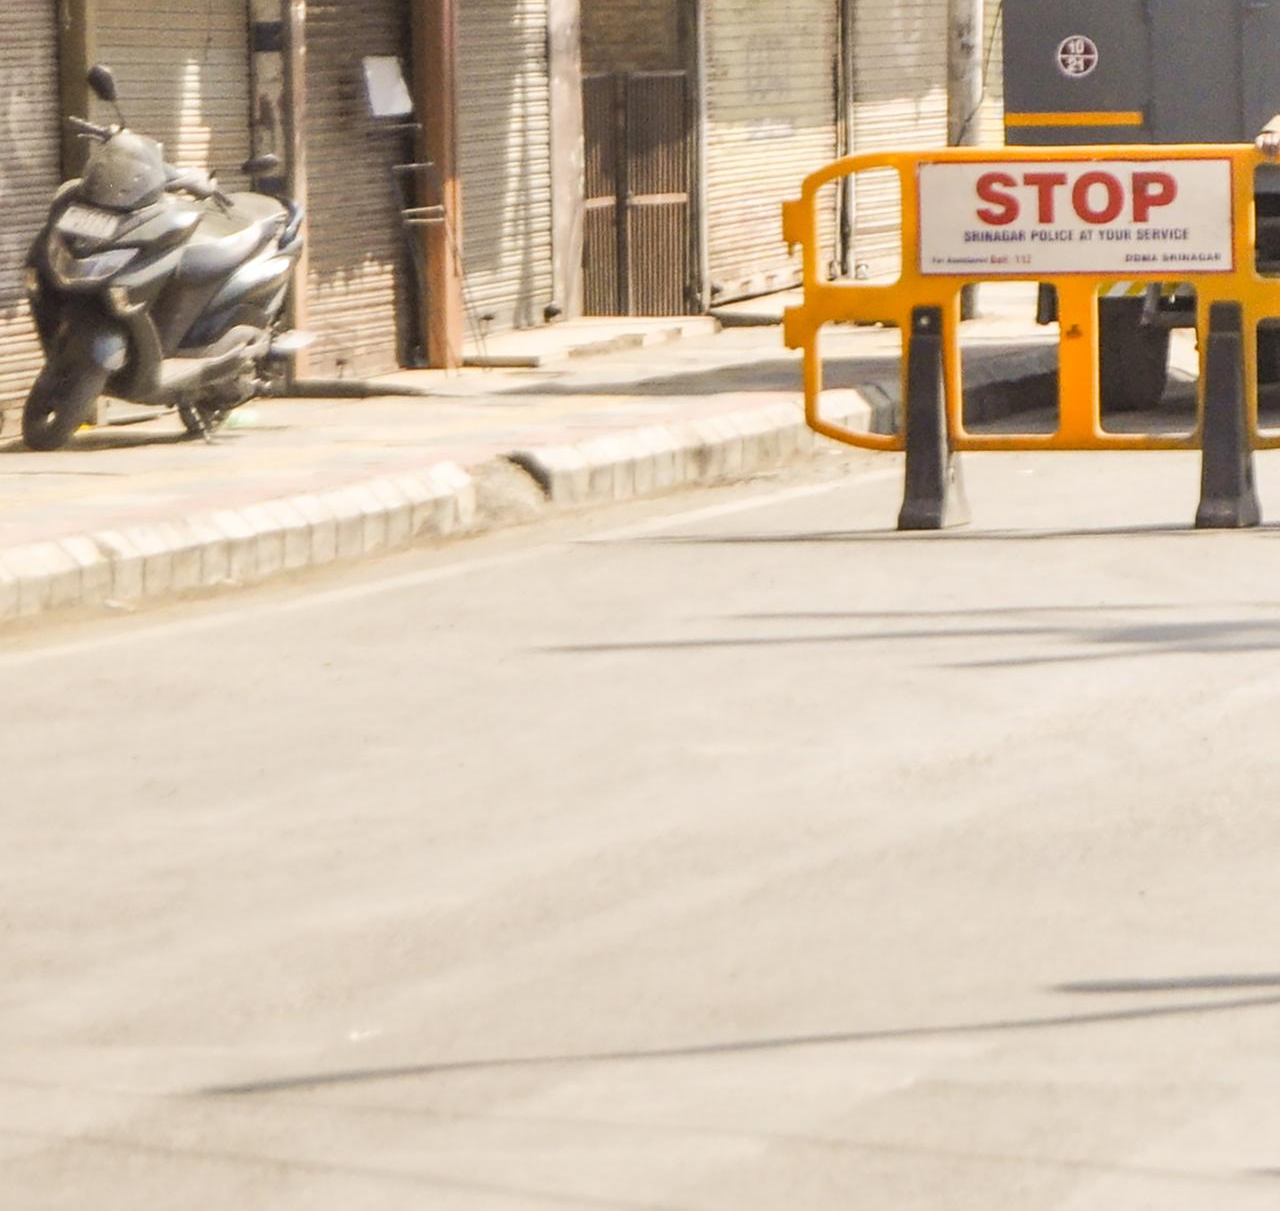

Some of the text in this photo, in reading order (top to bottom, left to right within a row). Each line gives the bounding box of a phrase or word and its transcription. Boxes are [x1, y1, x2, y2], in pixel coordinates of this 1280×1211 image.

[1069, 38, 1085, 54] 10
[975, 170, 1179, 226] STOP
[963, 228, 1189, 243] SRINAGAR POLICE AT YOUR SERVICE
[1162, 251, 1222, 262] SRINAGAR
